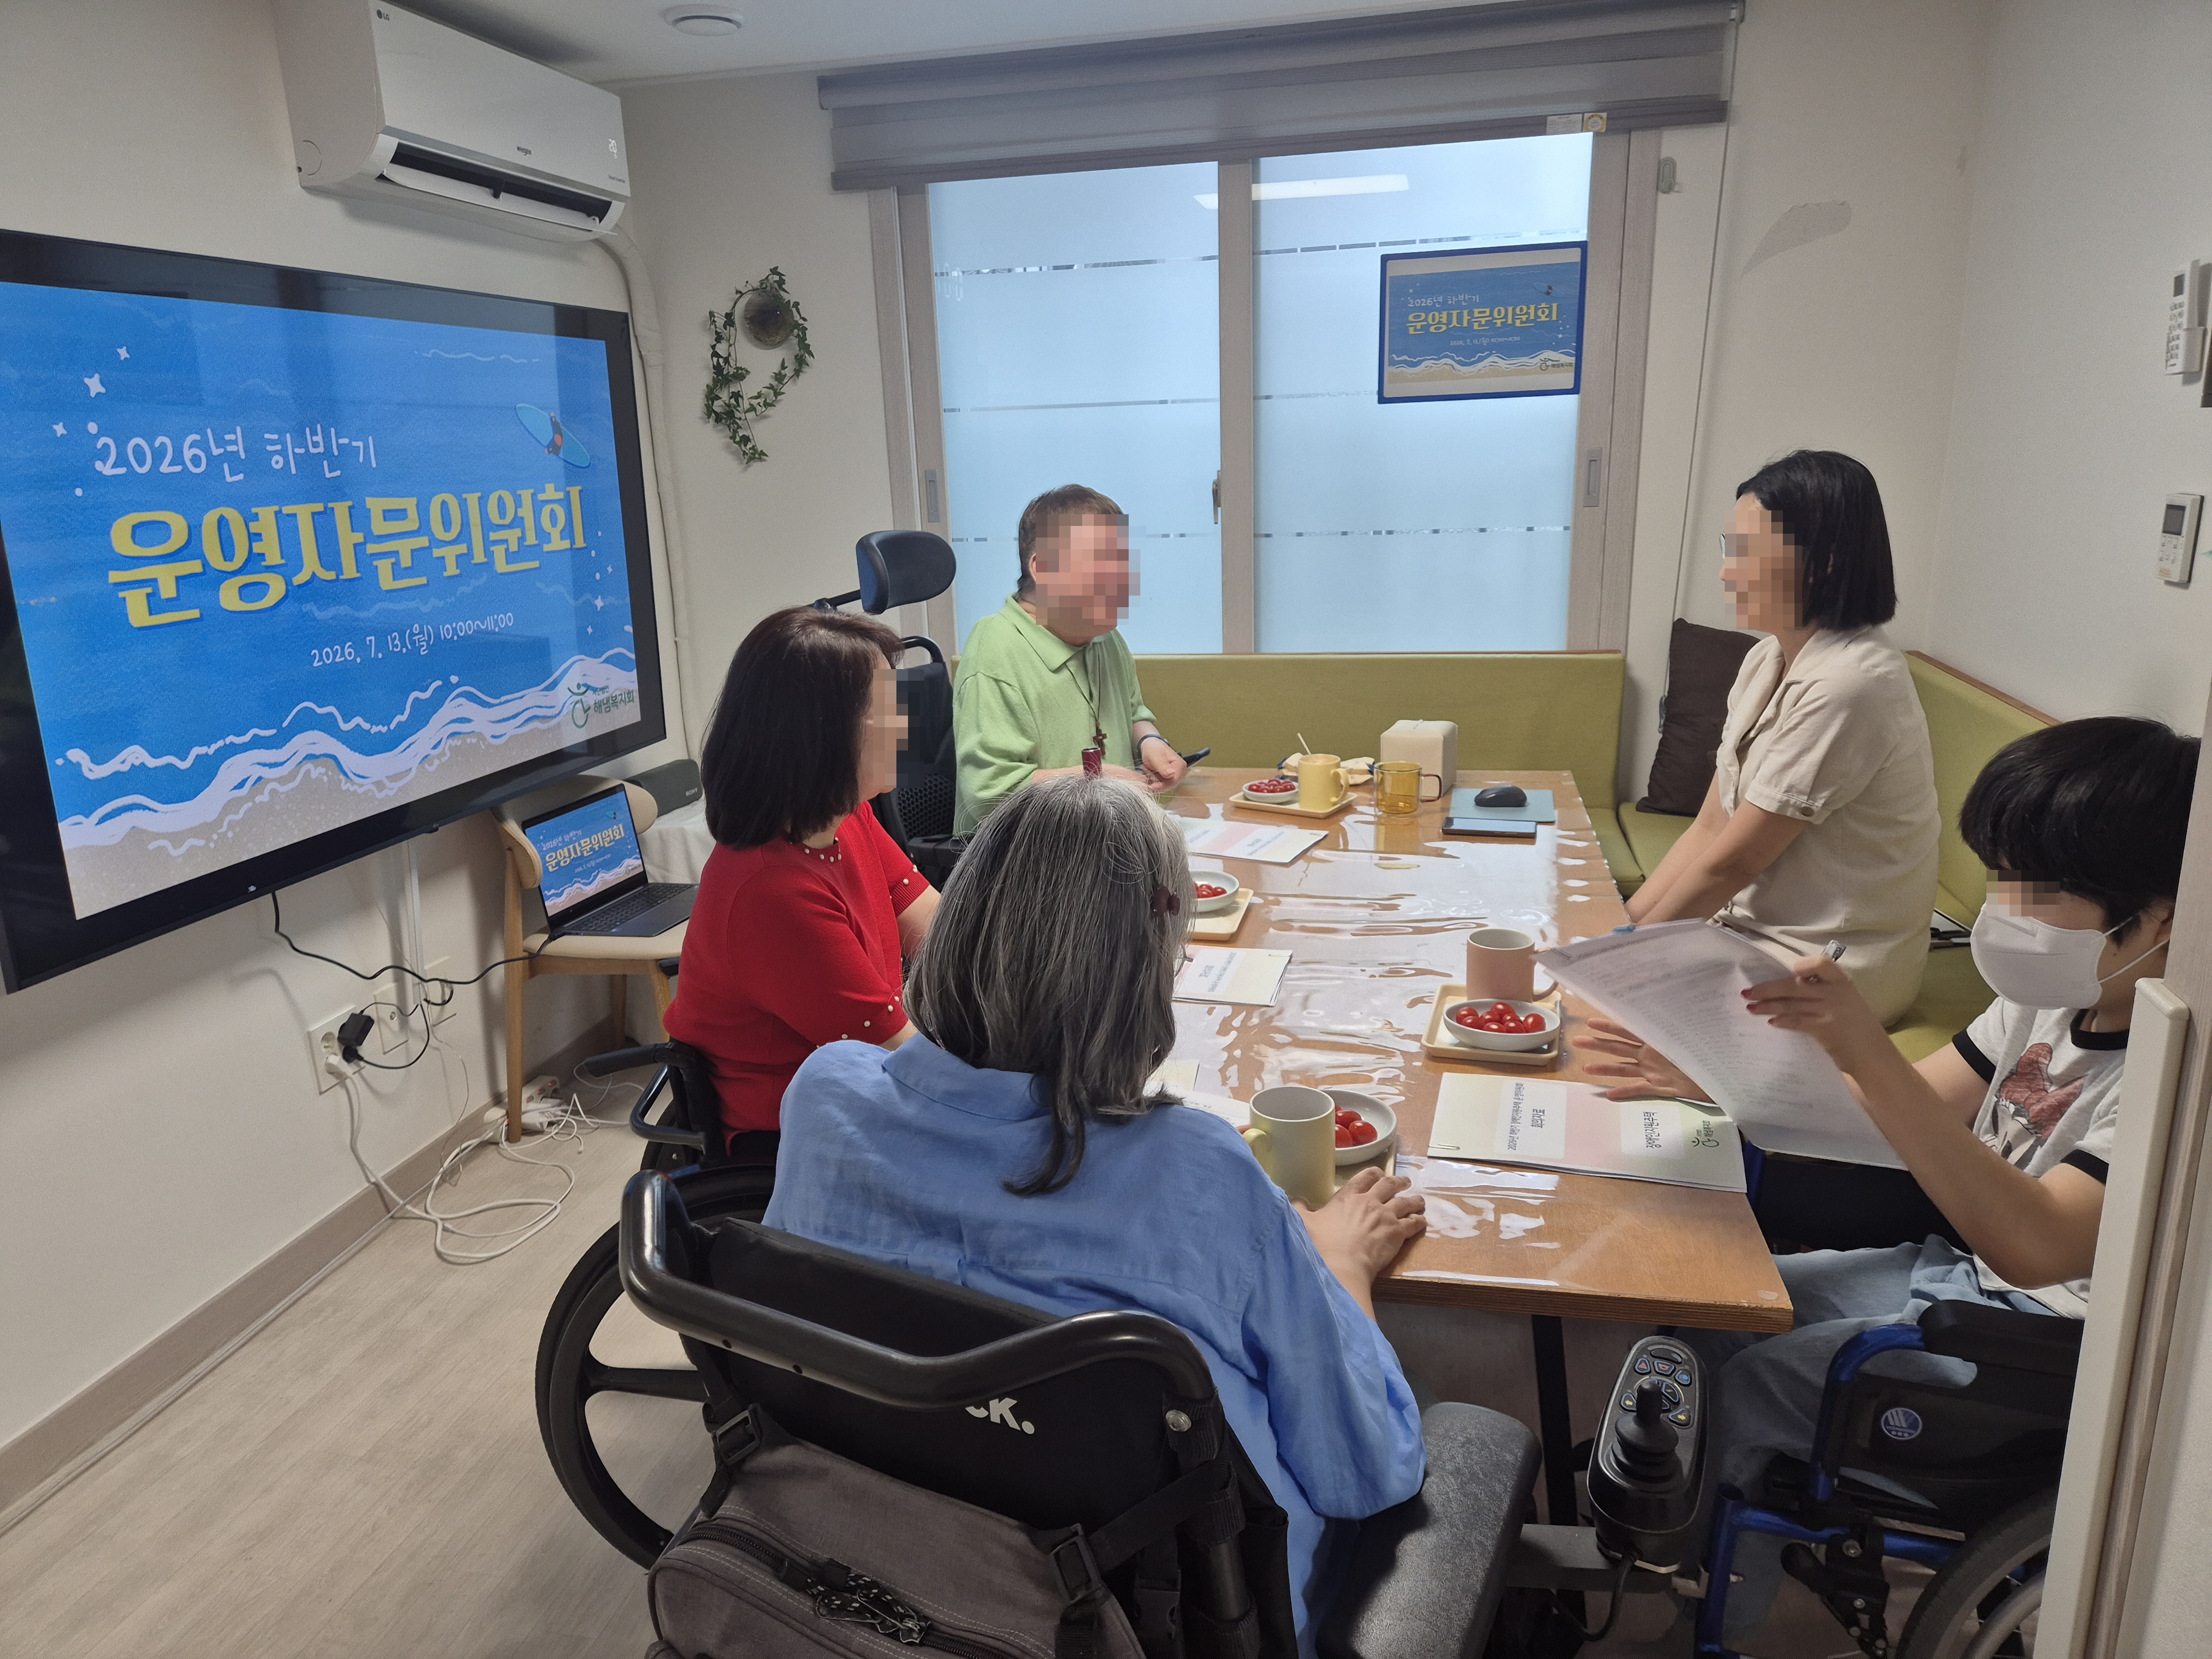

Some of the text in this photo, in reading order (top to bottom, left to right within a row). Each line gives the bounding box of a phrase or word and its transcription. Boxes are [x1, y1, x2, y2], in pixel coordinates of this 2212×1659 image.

[1406, 302, 1559, 335] 운영자문위원회
[1407, 293, 1479, 307] 2026년 하반기
[95, 424, 377, 482] 2026년 하반기
[108, 483, 587, 628] 운영자문위원회
[311, 642, 361, 667] 2026.
[366, 635, 383, 659] 7.
[440, 612, 514, 641] 10:00~11:00
[593, 689, 634, 714] 해냄복지회
[545, 823, 625, 872] 운영자문위원회
[1531, 1109, 1546, 1129] 회의자료
[1643, 1112, 1662, 1149] 장애인지원주택
